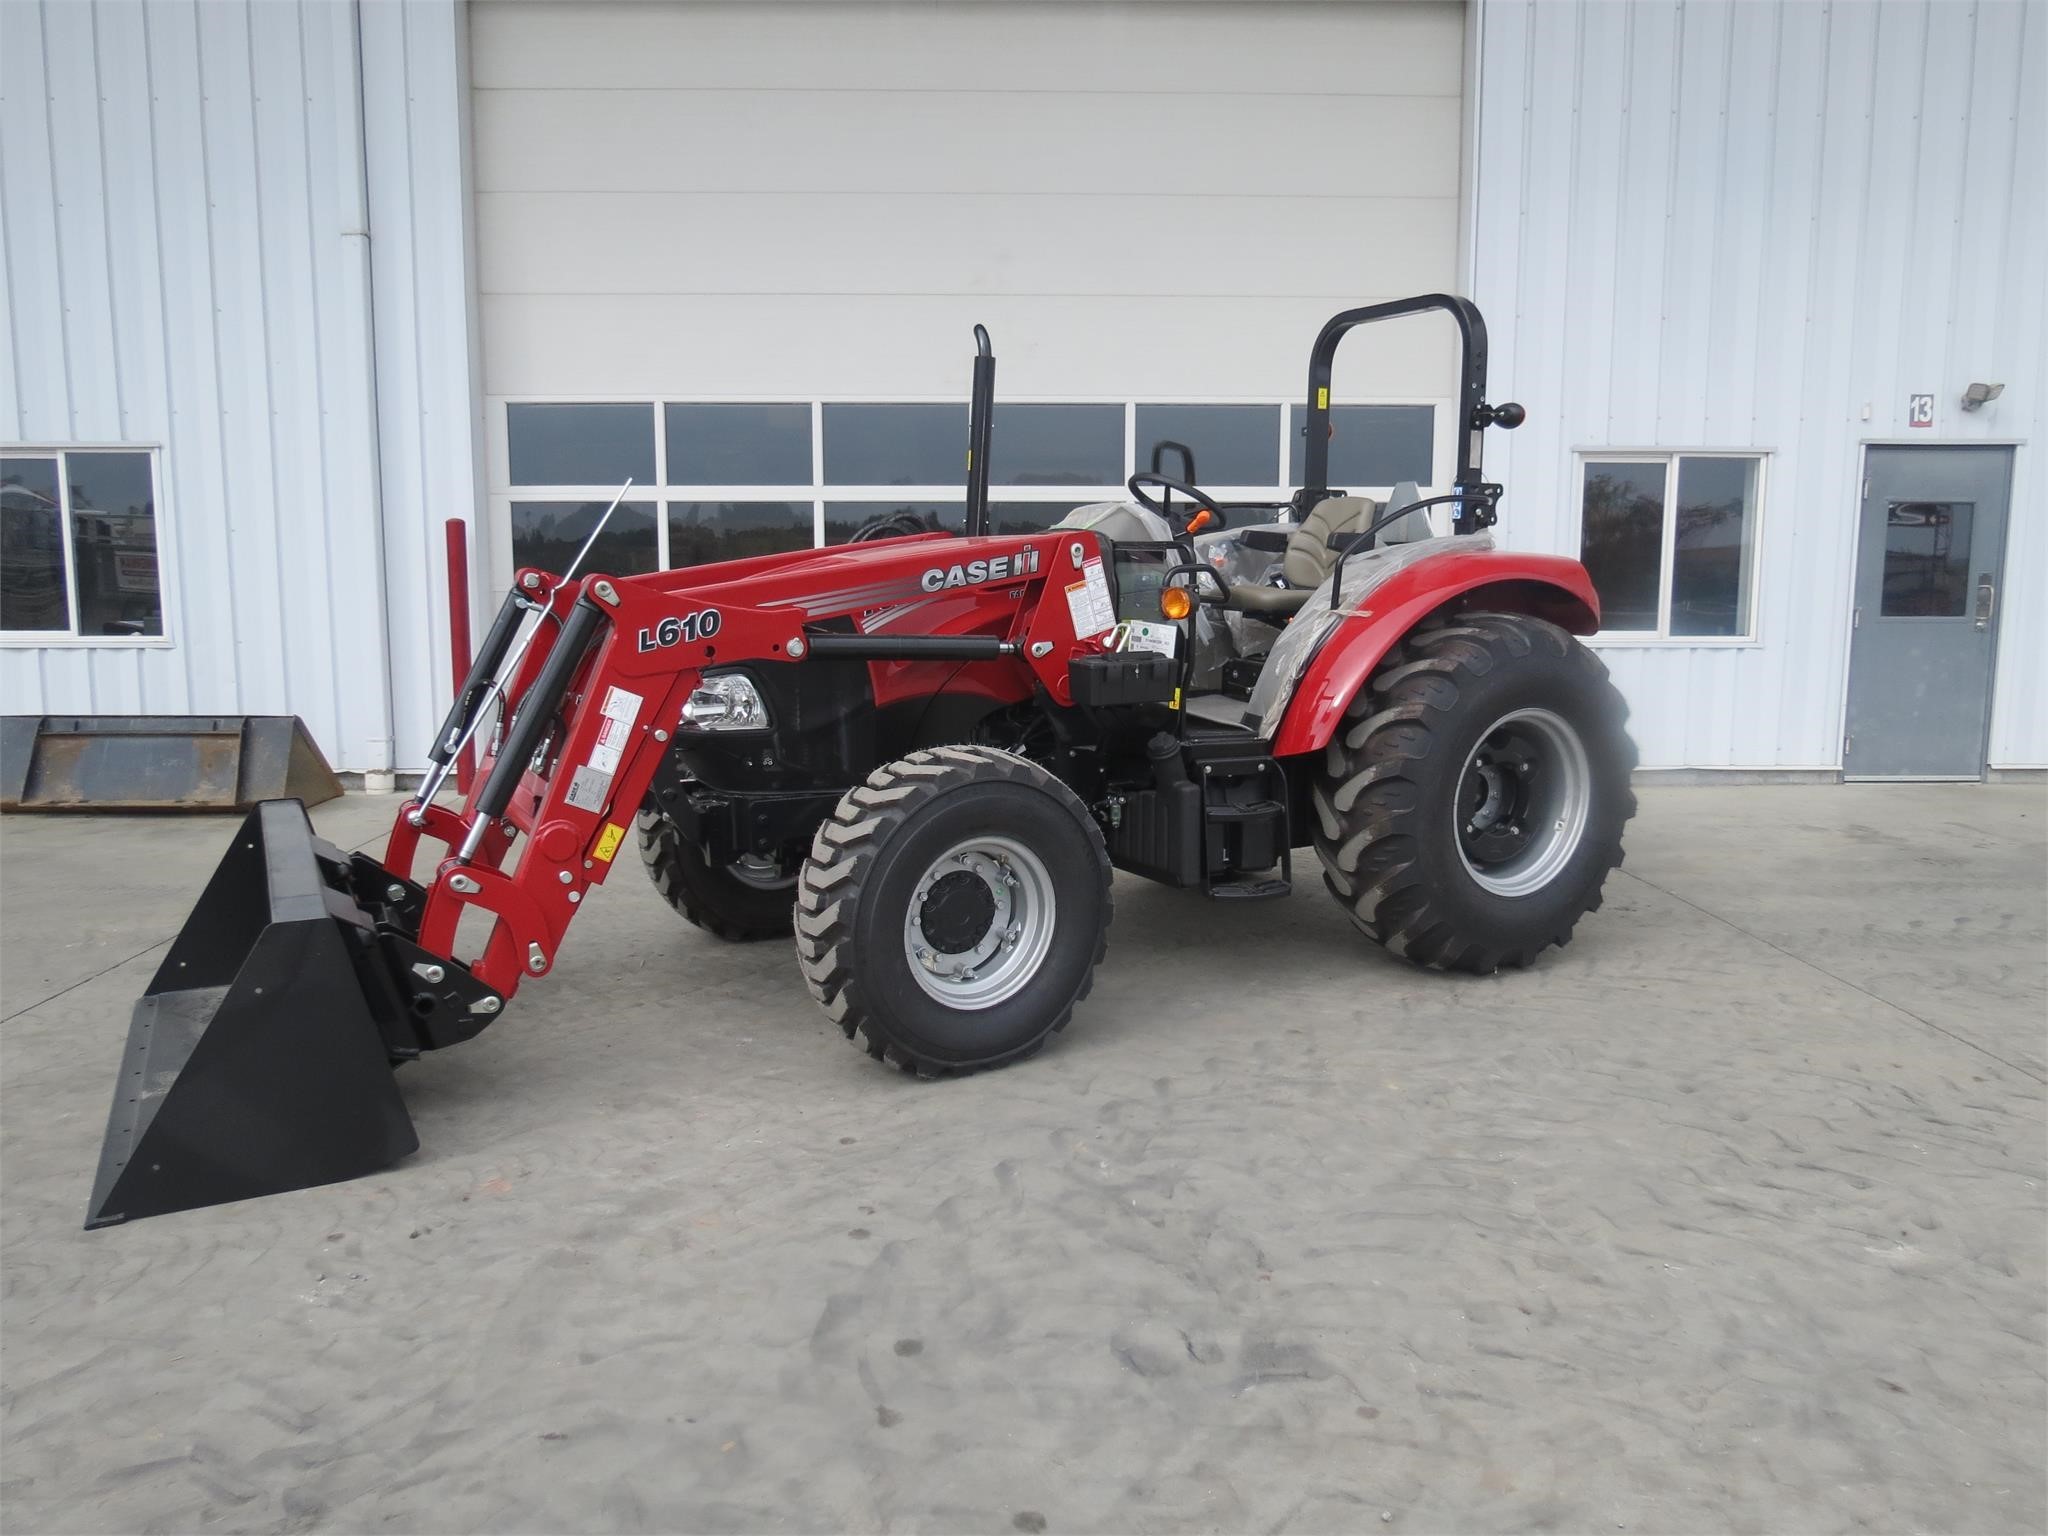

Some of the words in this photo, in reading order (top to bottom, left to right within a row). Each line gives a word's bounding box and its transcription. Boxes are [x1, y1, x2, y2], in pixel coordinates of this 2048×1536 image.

[1911, 396, 1932, 422] 13
[921, 555, 1009, 593] CASE
[638, 608, 722, 653] L610
